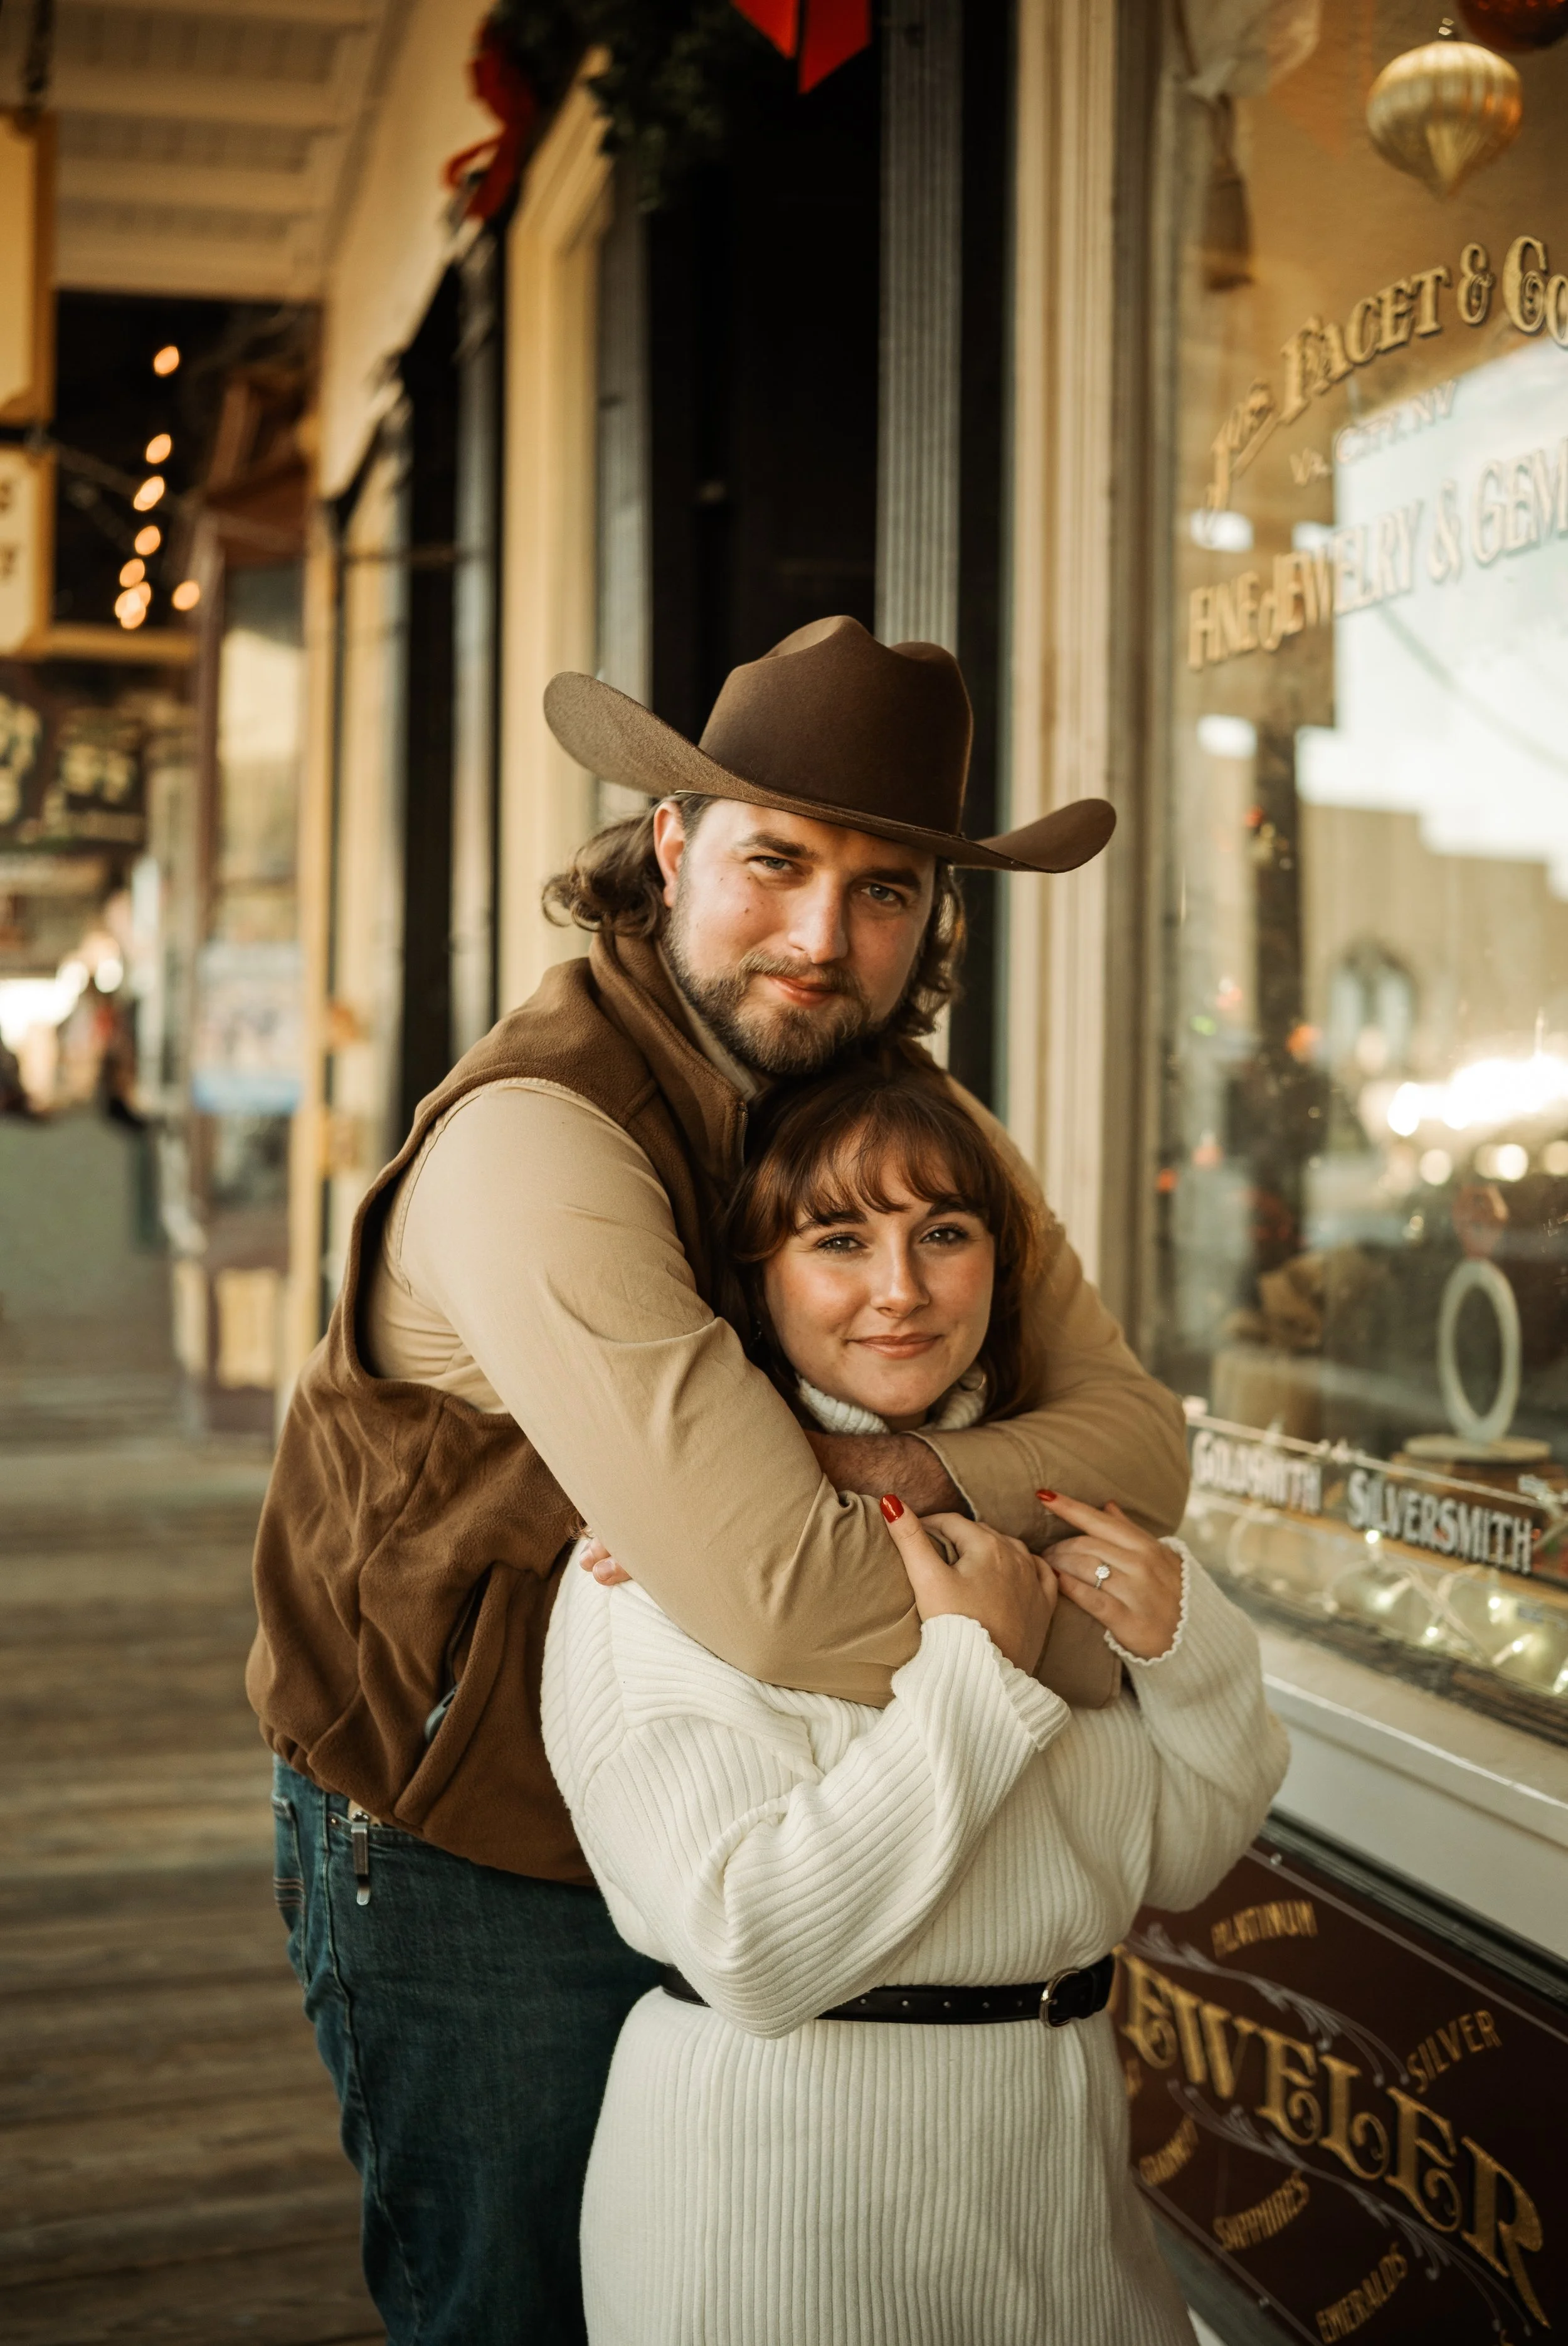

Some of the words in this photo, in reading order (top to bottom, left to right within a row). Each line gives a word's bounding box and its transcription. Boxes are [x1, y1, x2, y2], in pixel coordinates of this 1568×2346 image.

[1456, 242, 1493, 326] &
[1189, 571, 1259, 671] FINE
[1427, 479, 1463, 583] &
[1347, 1468, 1532, 1572] SILVERSMITH
[1407, 2009, 1502, 2094] SILVER
